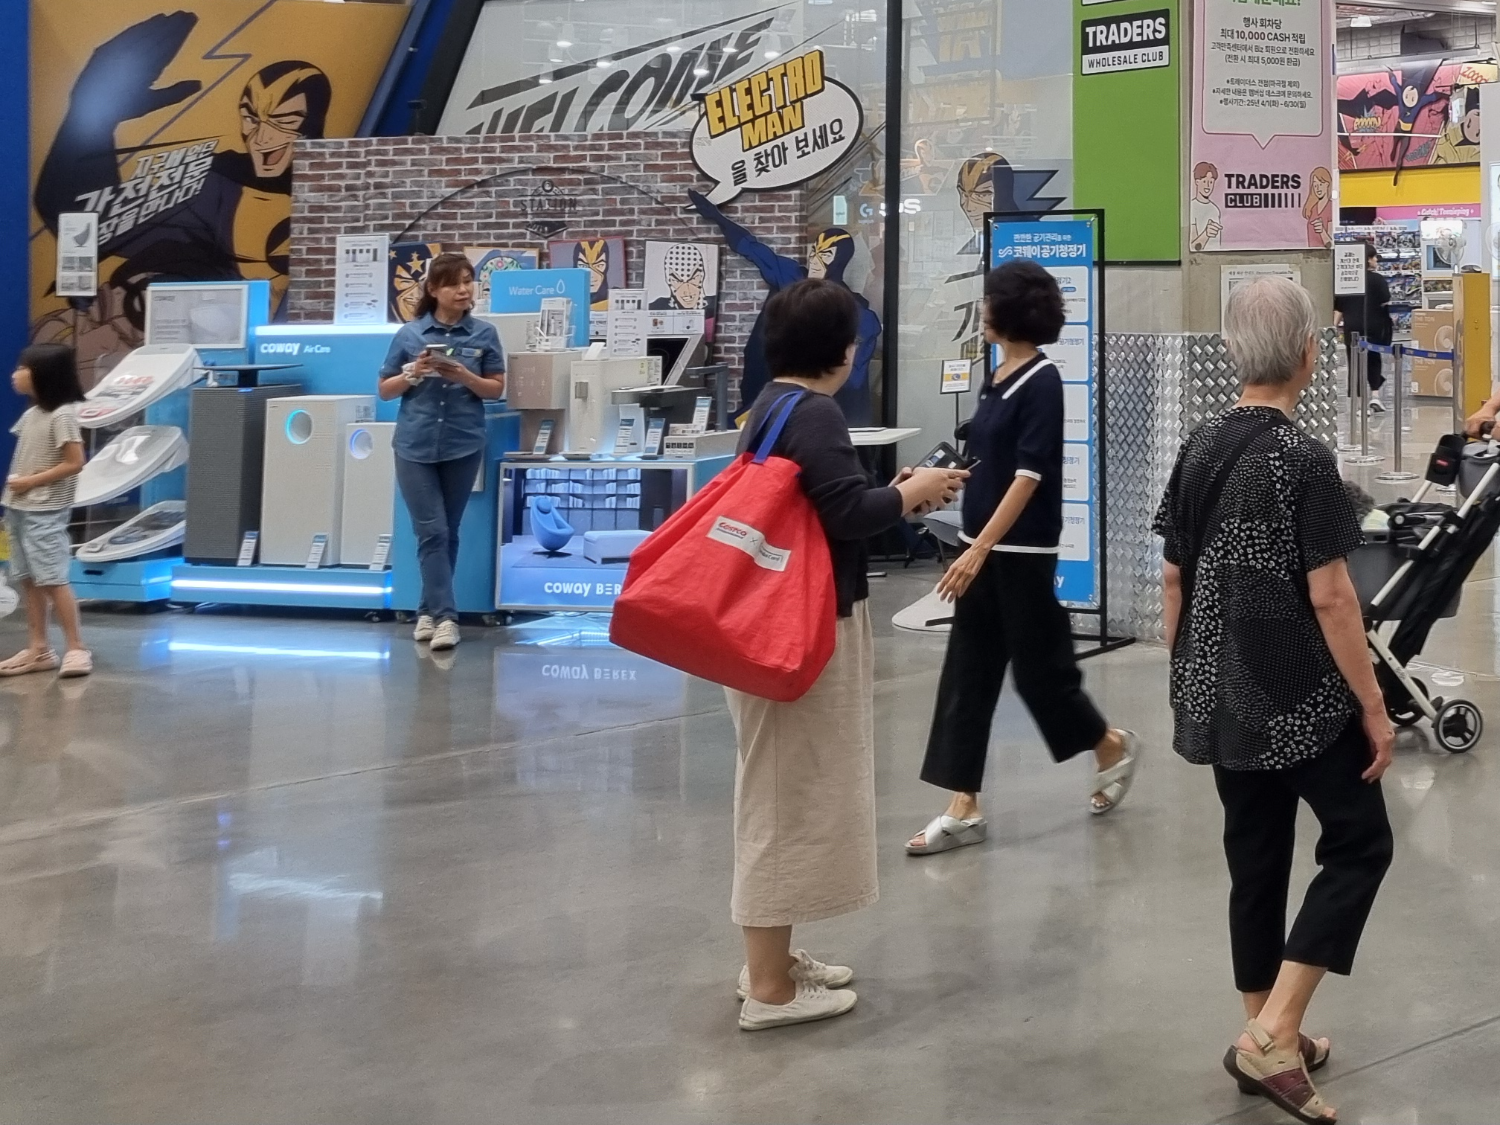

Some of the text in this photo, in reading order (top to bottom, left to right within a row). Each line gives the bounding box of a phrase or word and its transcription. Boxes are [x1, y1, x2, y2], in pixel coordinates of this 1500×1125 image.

[1085, 17, 1166, 48] TRADERS
[1087, 50, 1163, 68] WHOLESALE CLUB
[704, 50, 825, 137] ELECTRO
[740, 99, 805, 152] MAN
[730, 118, 847, 184] 을 찾아 보세요
[1224, 173, 1301, 189] TRADERS
[1227, 194, 1260, 206] CLUB
[509, 285, 555, 296] Water Care
[260, 342, 300, 355] coway
[544, 581, 623, 597] coway BER
